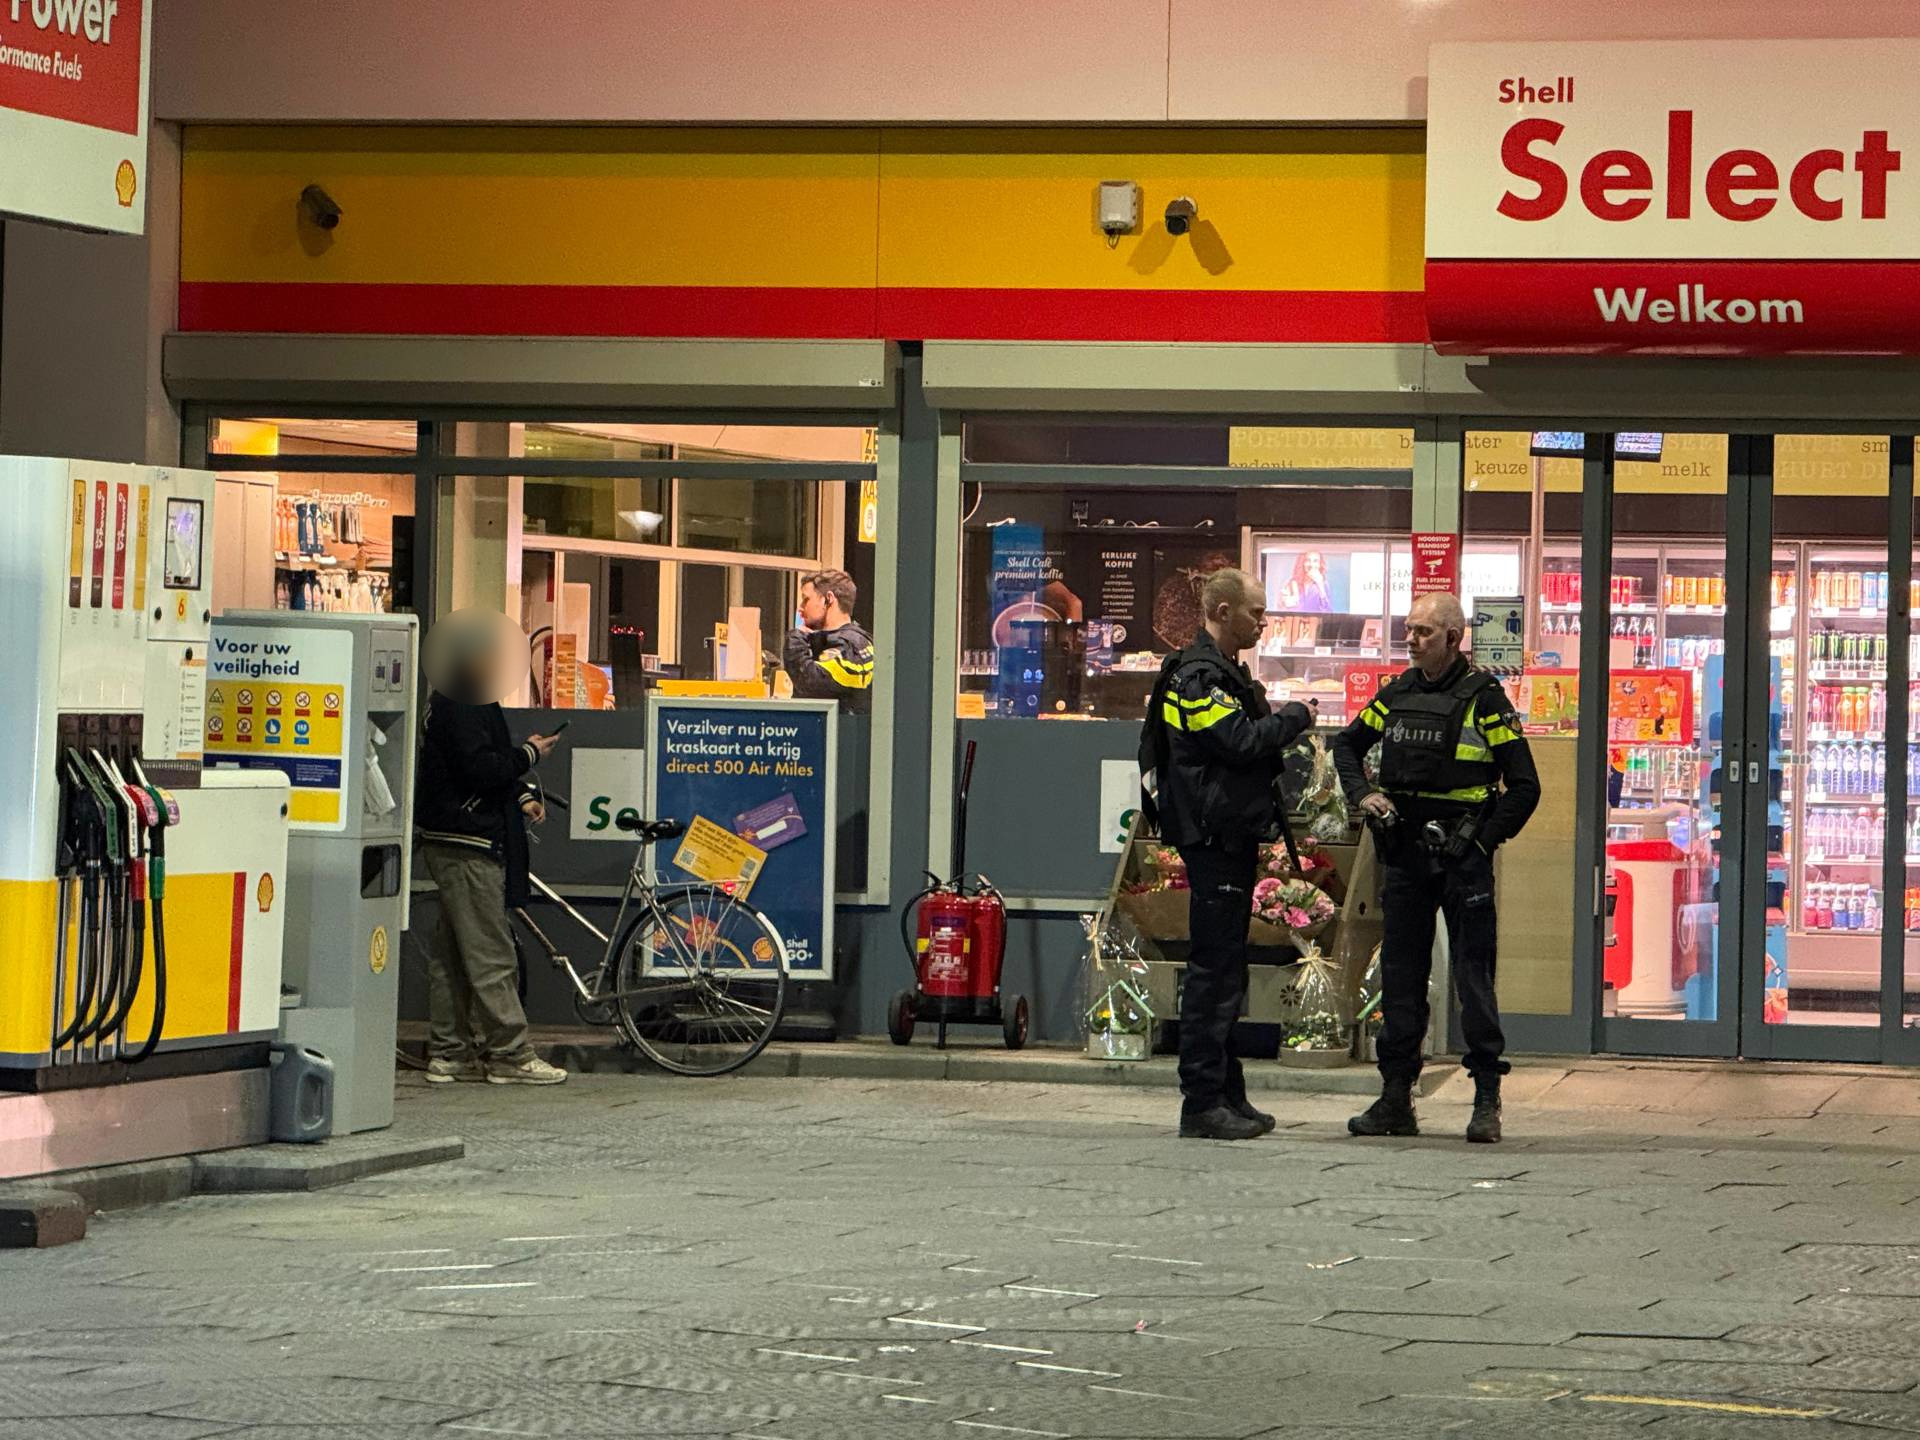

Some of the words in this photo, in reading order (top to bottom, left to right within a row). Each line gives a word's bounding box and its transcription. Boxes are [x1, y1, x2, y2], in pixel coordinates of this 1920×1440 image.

[53, 50, 82, 80] Fuels
[1499, 77, 1574, 103] Shell
[1496, 110, 1901, 222] Select
[1593, 284, 1804, 324] Welkom
[1475, 461, 1528, 475] keuze
[1662, 462, 1711, 477] melk
[1007, 557, 1030, 568] Shell
[1101, 552, 1137, 560] EERLIJKE
[1105, 560, 1133, 568] KOFFIE
[994, 568, 1036, 582] premium
[1038, 568, 1064, 579] koffie
[178, 598, 185, 617] 6
[215, 638, 258, 654] Voor
[264, 644, 291, 655] uw
[214, 658, 300, 678] veiligheid
[667, 719, 734, 735] Verzilver
[738, 726, 756, 736] nu
[760, 722, 798, 740] jouw
[666, 738, 741, 755] kraskaart
[745, 744, 763, 756] en
[768, 741, 801, 760] krijg
[666, 758, 710, 773] direct
[714, 760, 744, 774] 500
[748, 761, 771, 775] Air
[775, 762, 814, 777] Miles
[786, 938, 808, 948] Shell
